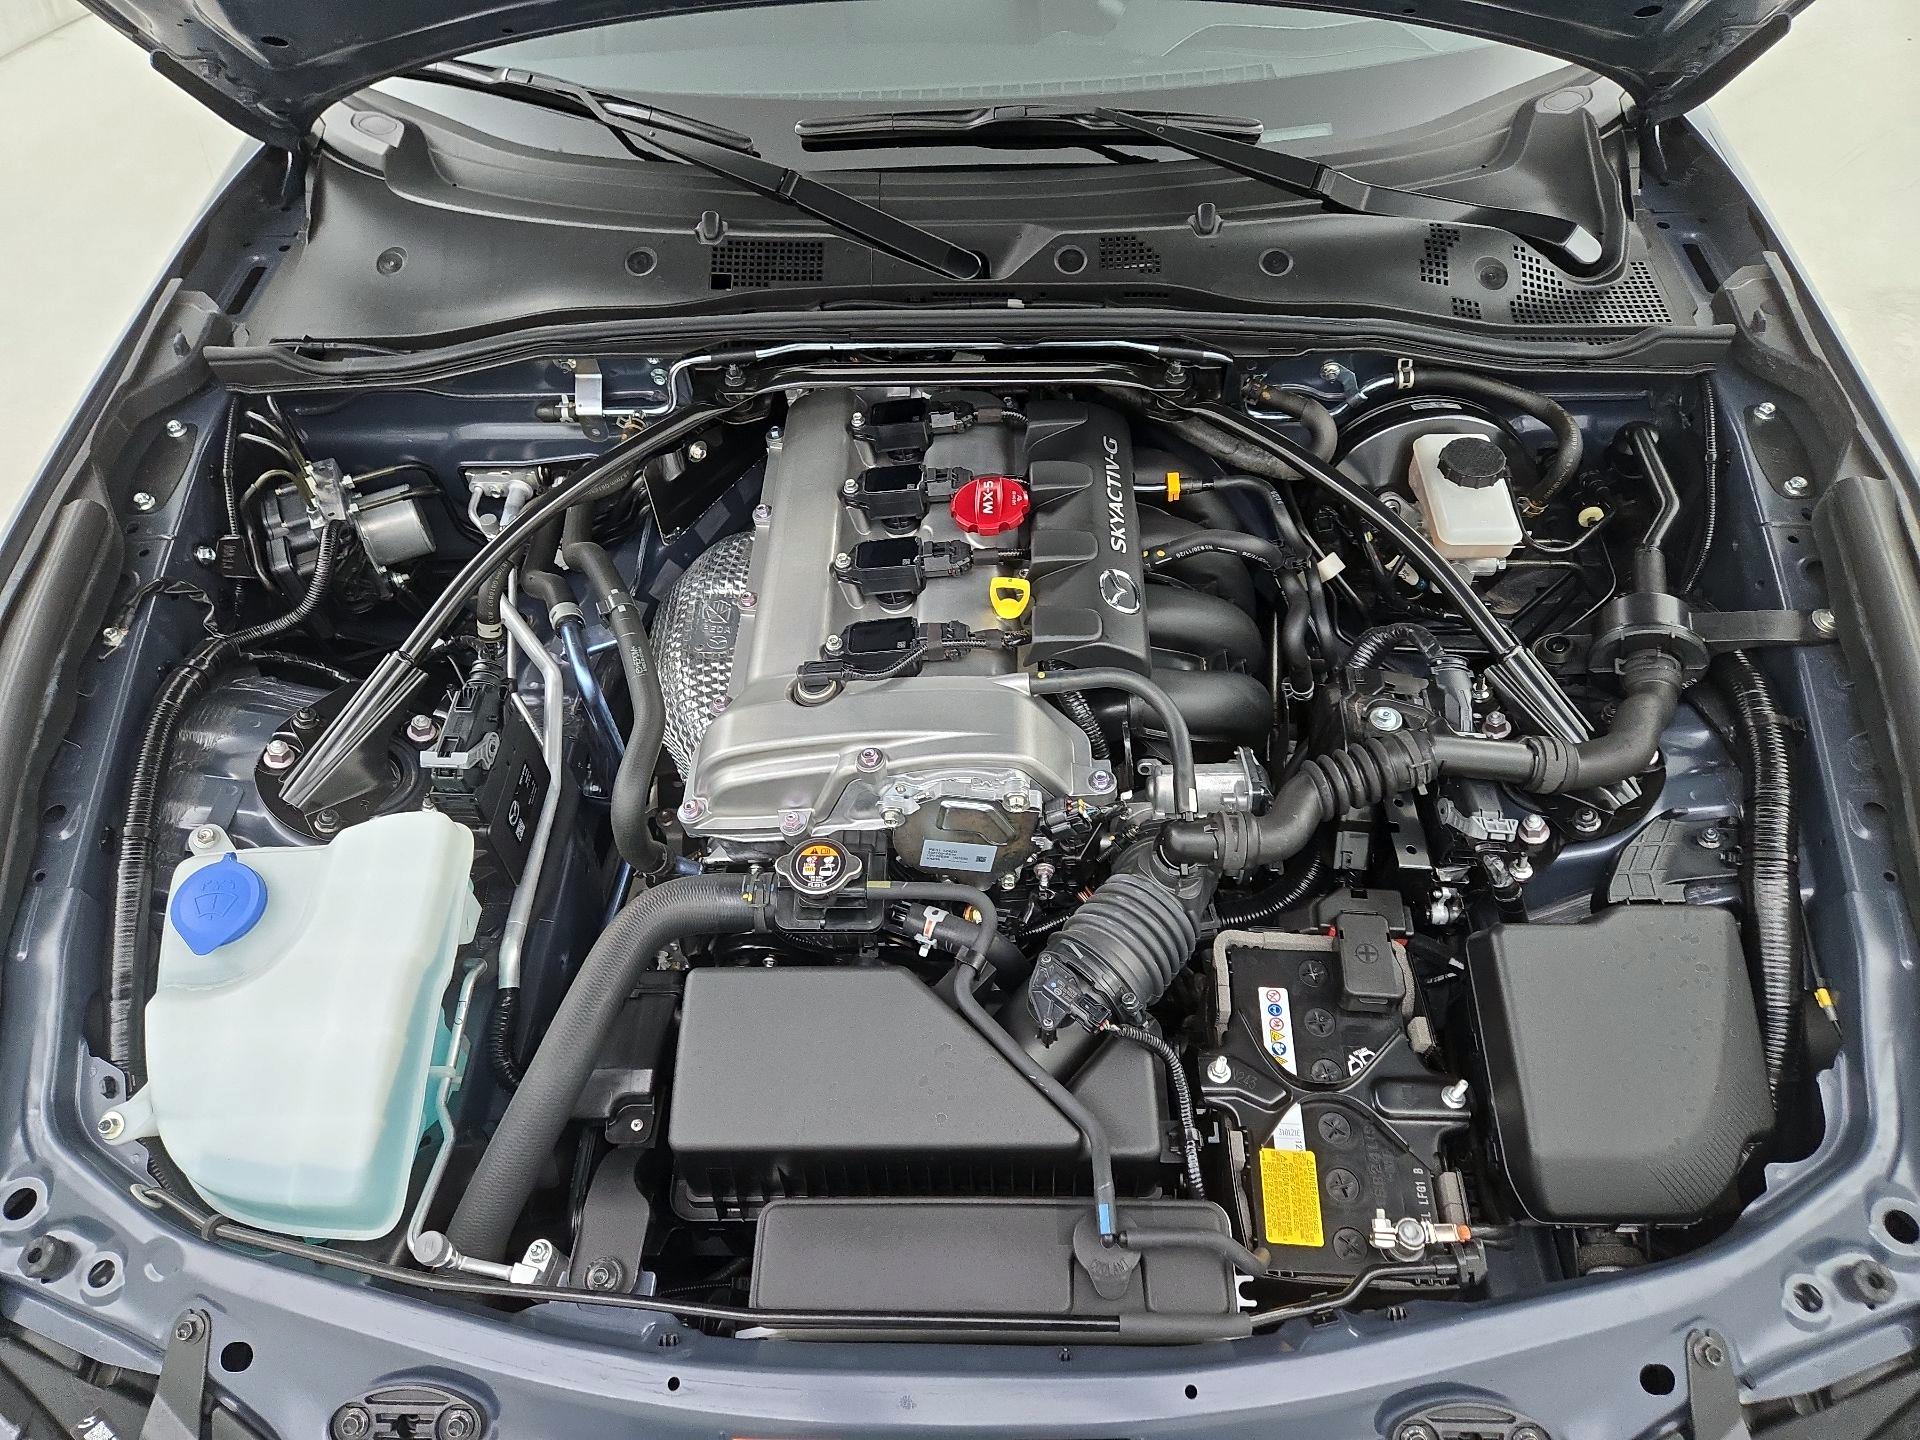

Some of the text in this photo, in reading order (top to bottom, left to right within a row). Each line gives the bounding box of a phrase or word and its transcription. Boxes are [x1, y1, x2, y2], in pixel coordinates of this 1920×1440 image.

[982, 480, 994, 514] MX-5
[1102, 435, 1128, 554] SKYACTIV-G
[1307, 1167, 1318, 1195] DANGER
[1413, 1167, 1424, 1175] B
